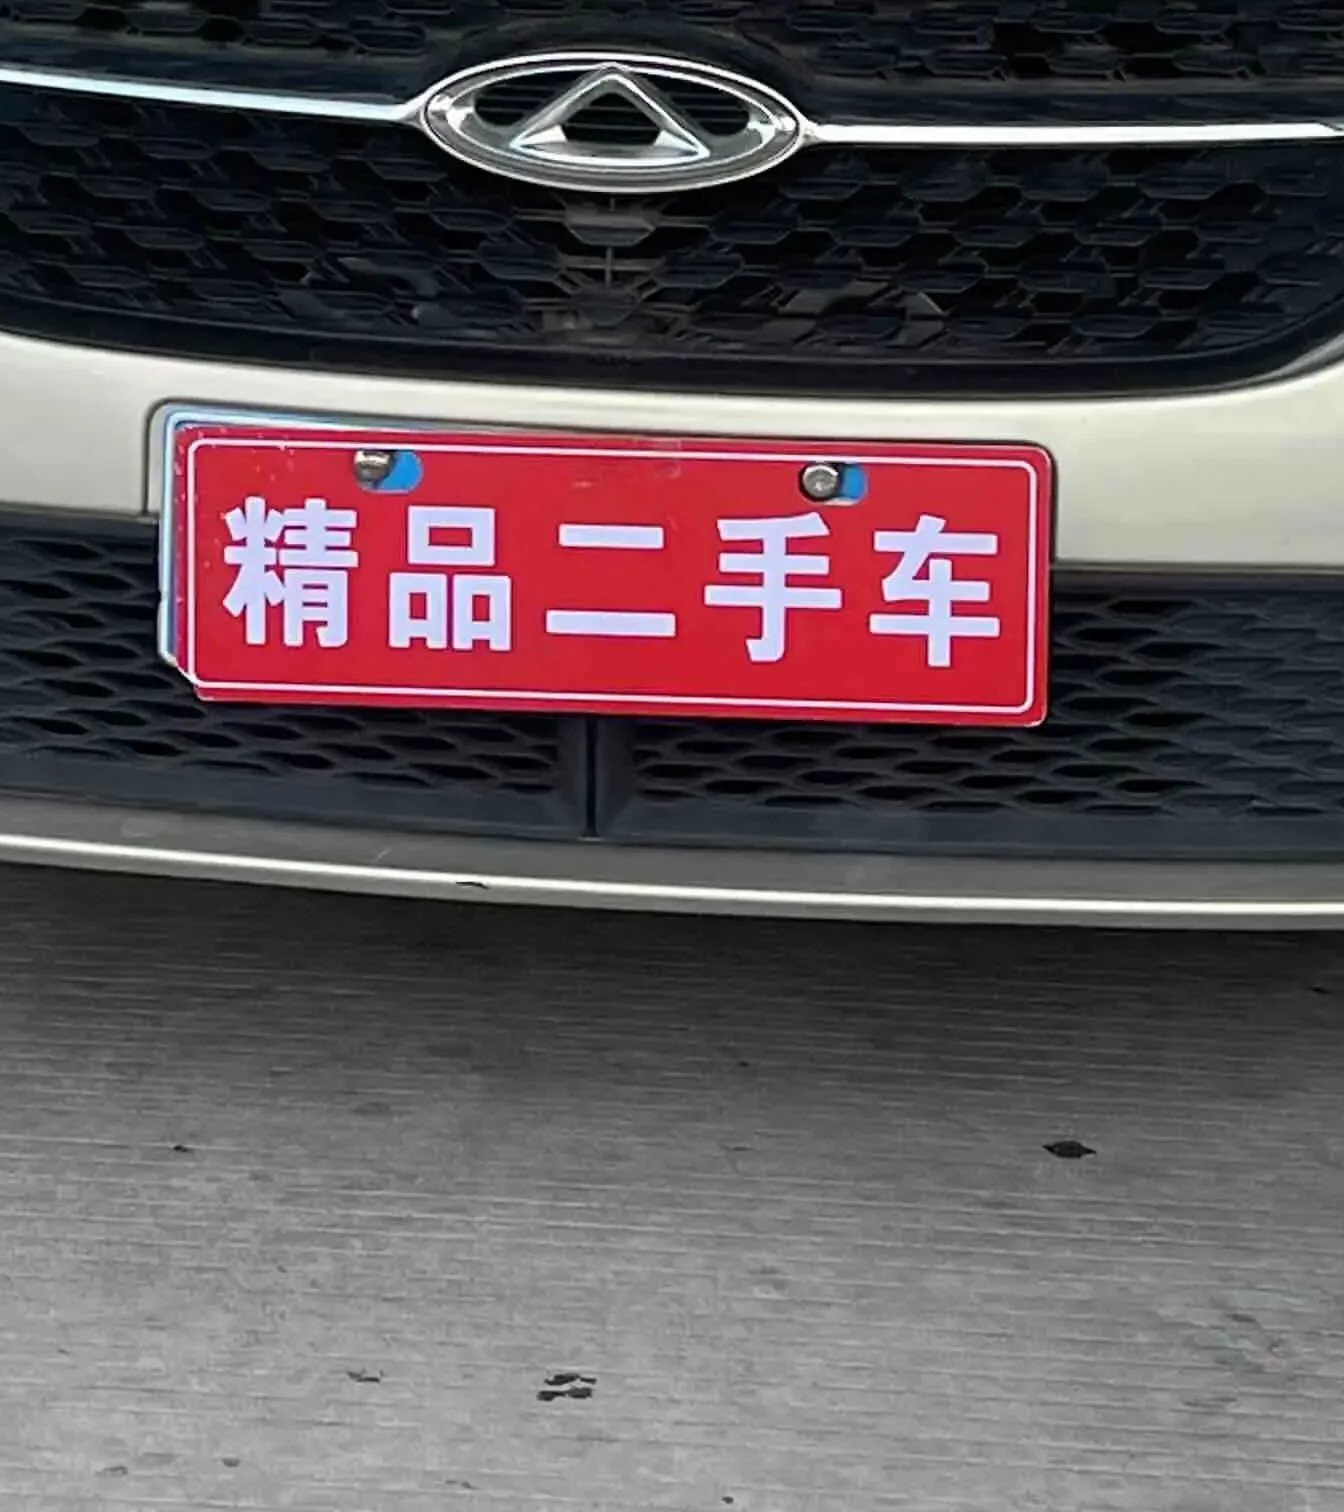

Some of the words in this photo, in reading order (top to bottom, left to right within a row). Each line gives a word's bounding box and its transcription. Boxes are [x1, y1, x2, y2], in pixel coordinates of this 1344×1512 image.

[222, 495, 1002, 668] 精品二手车
